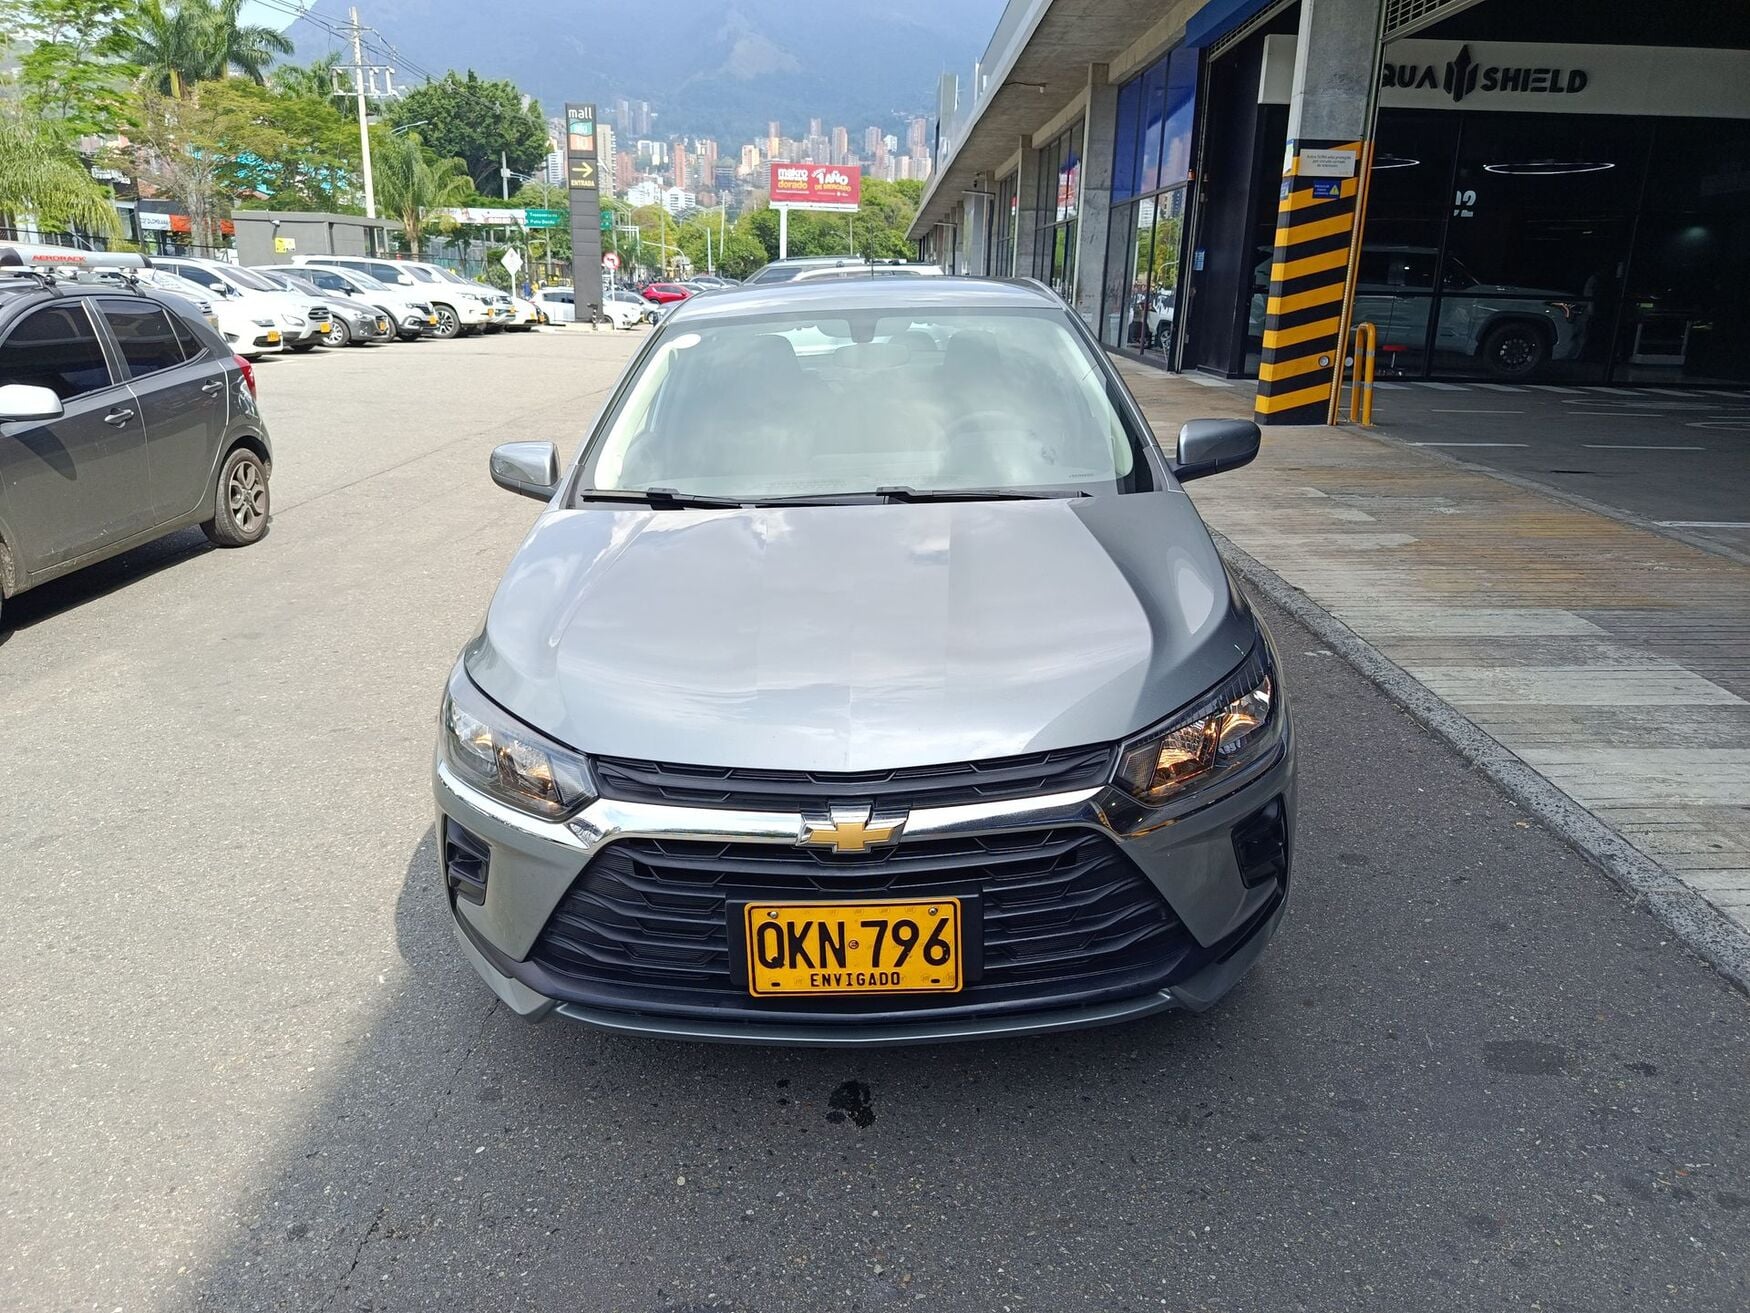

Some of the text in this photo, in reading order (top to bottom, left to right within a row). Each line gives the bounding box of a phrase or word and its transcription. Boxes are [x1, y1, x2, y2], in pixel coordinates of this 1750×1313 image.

[1480, 67, 1588, 94] SHIELD
[568, 106, 592, 119] mall
[570, 179, 595, 187] ENTRADA
[777, 180, 808, 190] dorado
[756, 917, 951, 969] QKN 796
[810, 971, 901, 987] ENVIGADO
